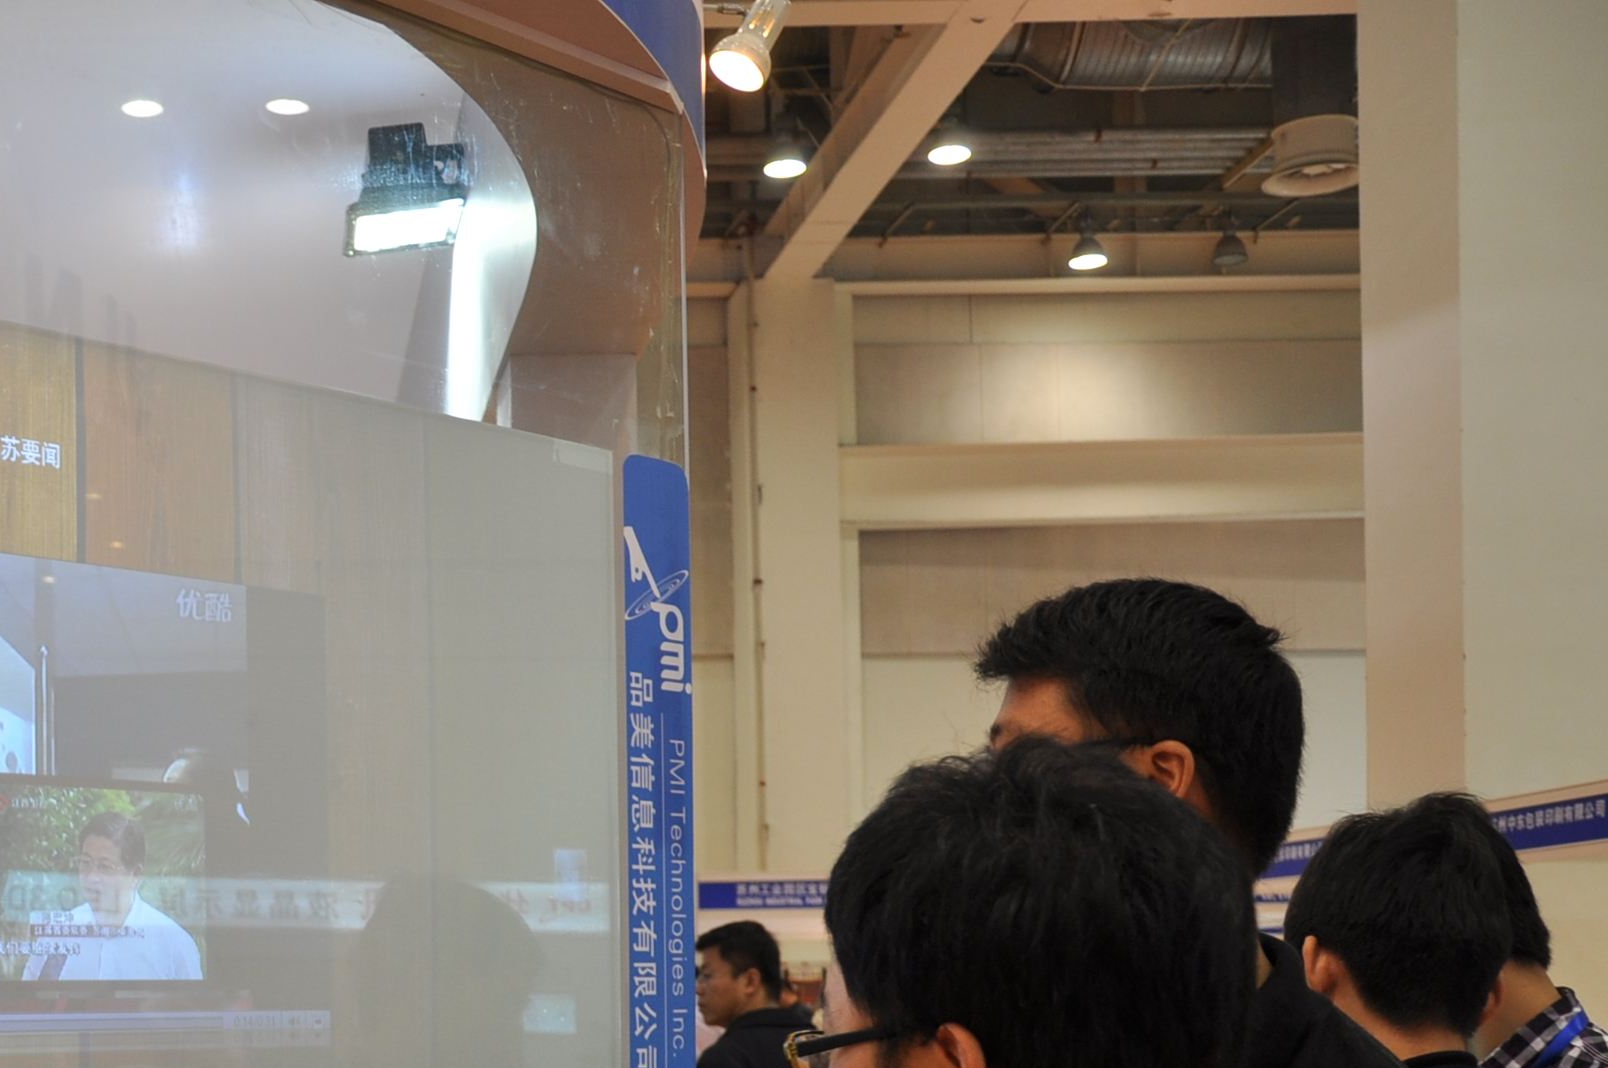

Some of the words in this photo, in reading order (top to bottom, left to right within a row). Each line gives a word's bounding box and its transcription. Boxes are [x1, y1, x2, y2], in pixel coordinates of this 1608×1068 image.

[176, 587, 232, 623] 优酷
[651, 602, 692, 695] pmi
[668, 738, 687, 795] PMI
[668, 806, 688, 996] Technologies
[671, 1009, 687, 1057] Inc.
